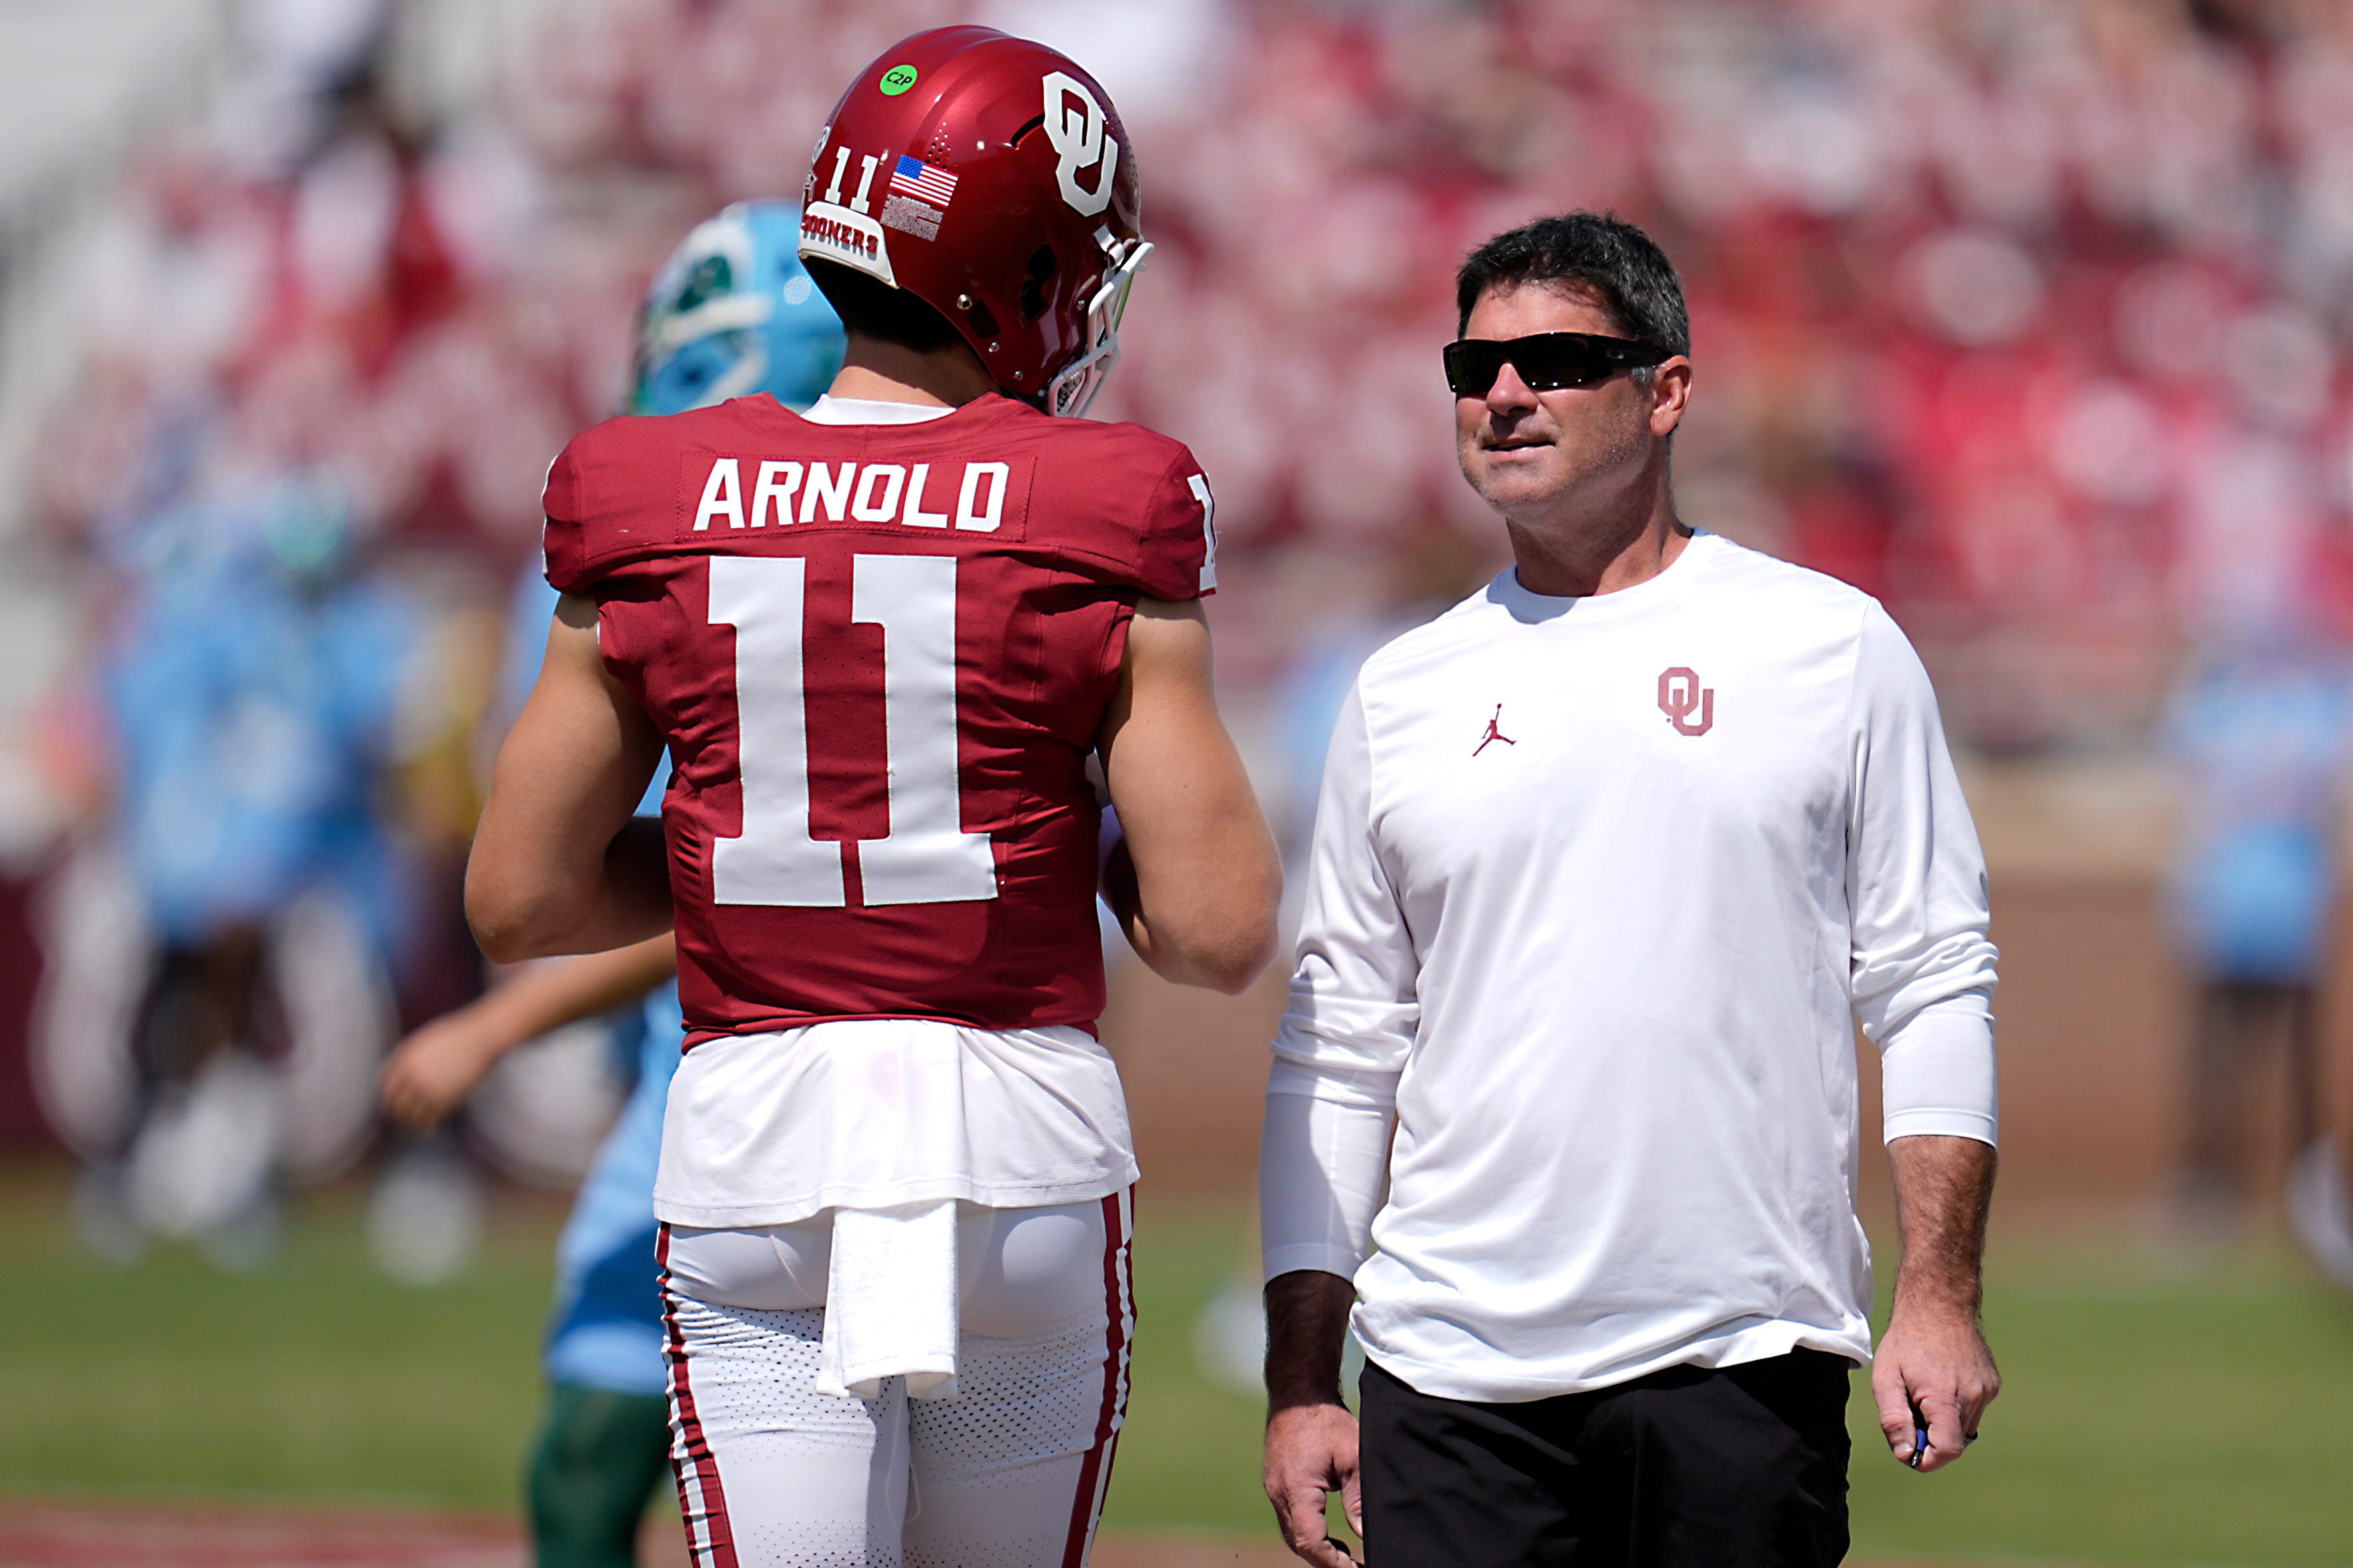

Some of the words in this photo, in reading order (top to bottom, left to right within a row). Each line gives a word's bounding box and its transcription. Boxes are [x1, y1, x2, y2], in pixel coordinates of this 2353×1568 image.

[886, 71, 912, 85] C2P
[824, 146, 878, 214] 11
[801, 214, 878, 254] SOONERS
[693, 458, 1009, 533] ARNOLD
[708, 553, 999, 906] 11
[1658, 667, 1714, 736] OU
